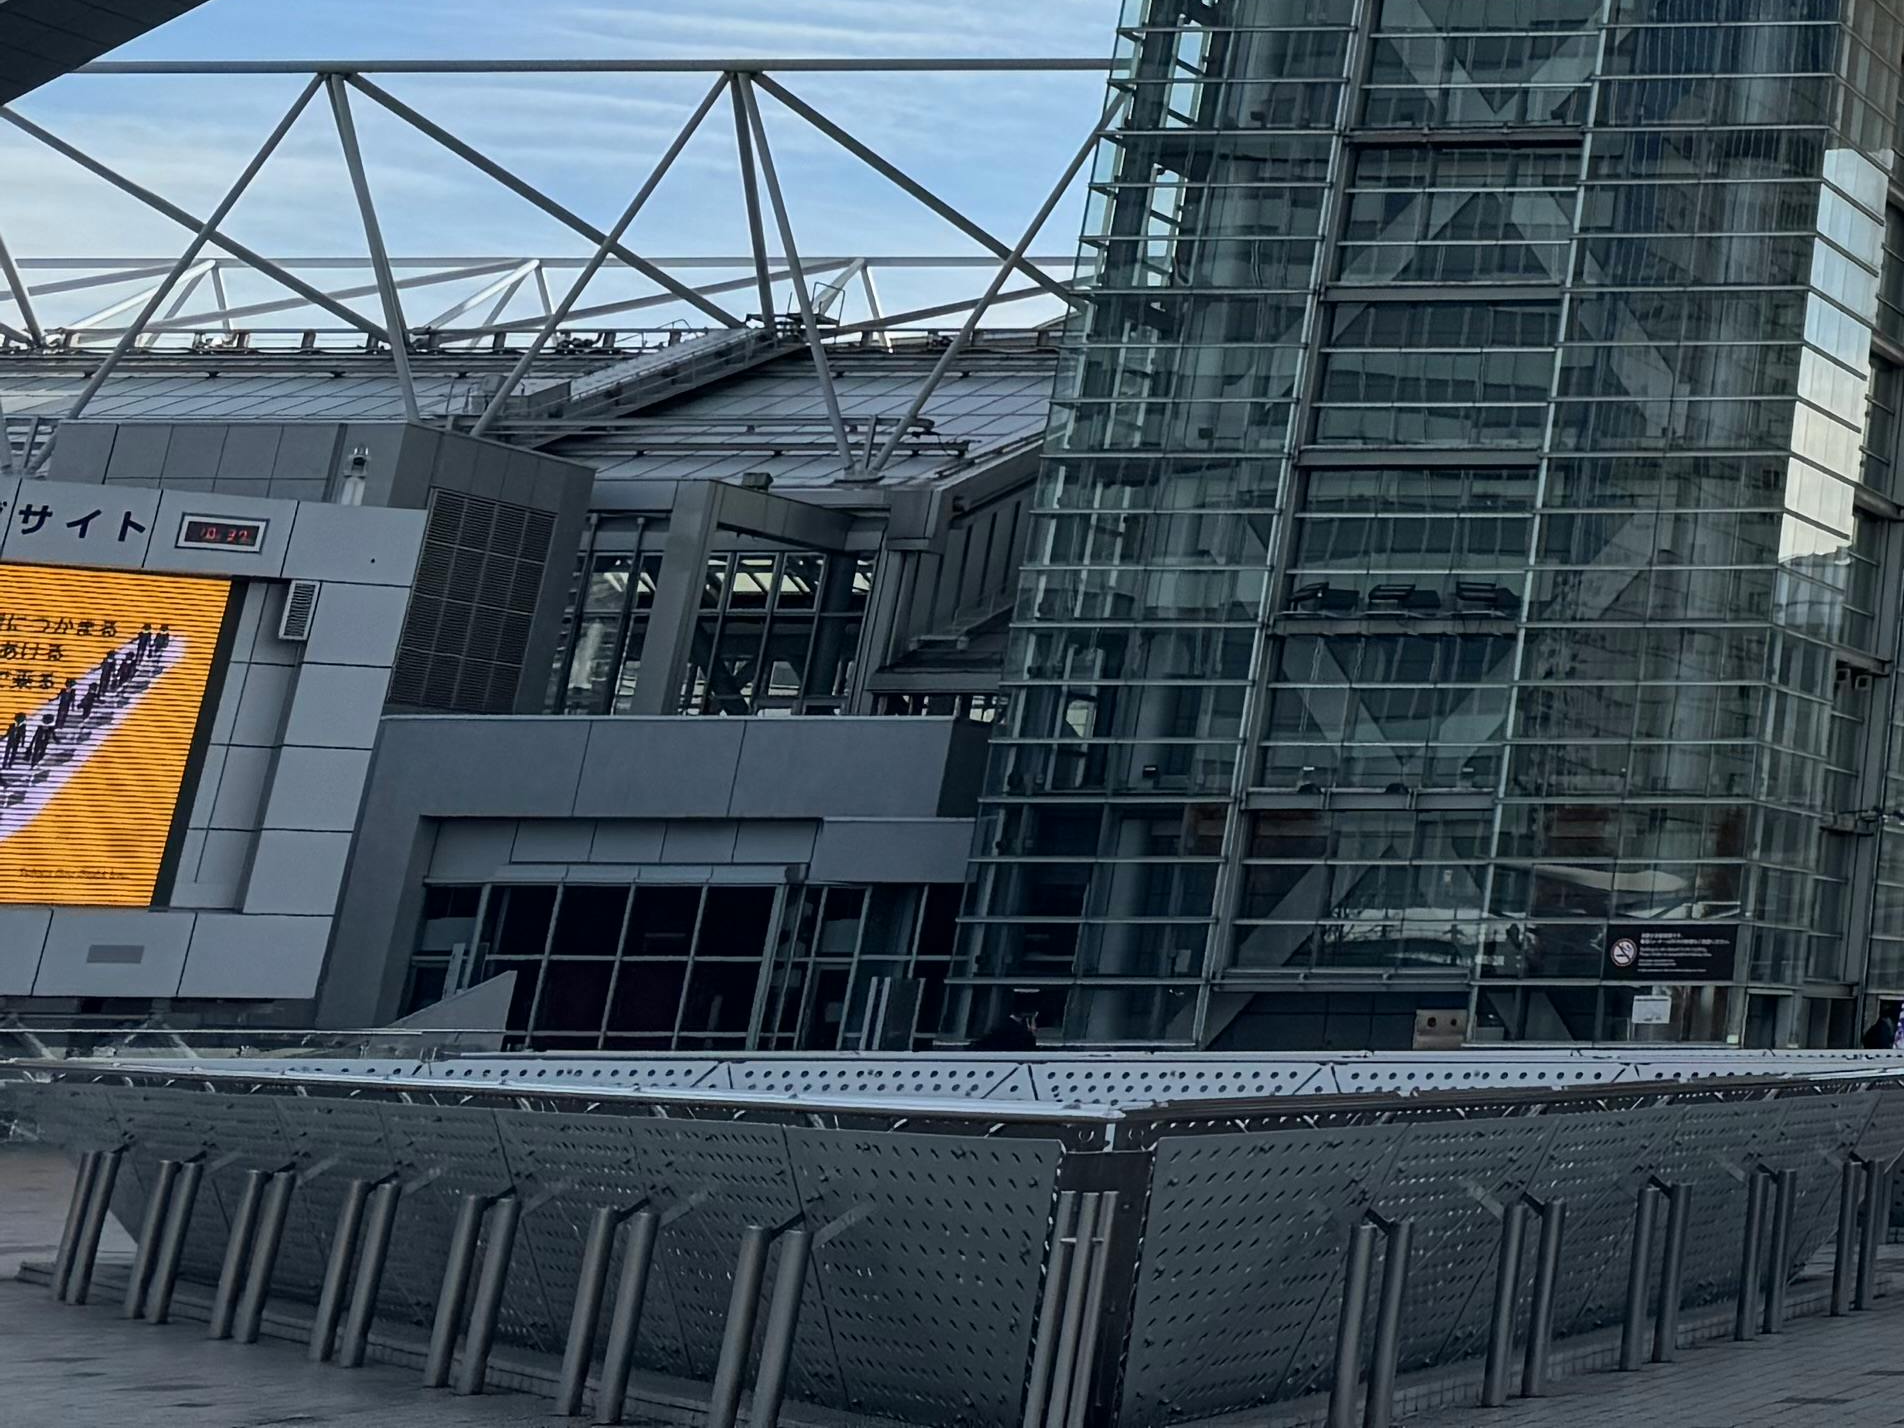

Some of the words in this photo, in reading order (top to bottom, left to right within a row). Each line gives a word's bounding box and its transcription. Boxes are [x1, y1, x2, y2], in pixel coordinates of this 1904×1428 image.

[0, 500, 146, 542] サイト
[0, 613, 117, 637] につかまる
